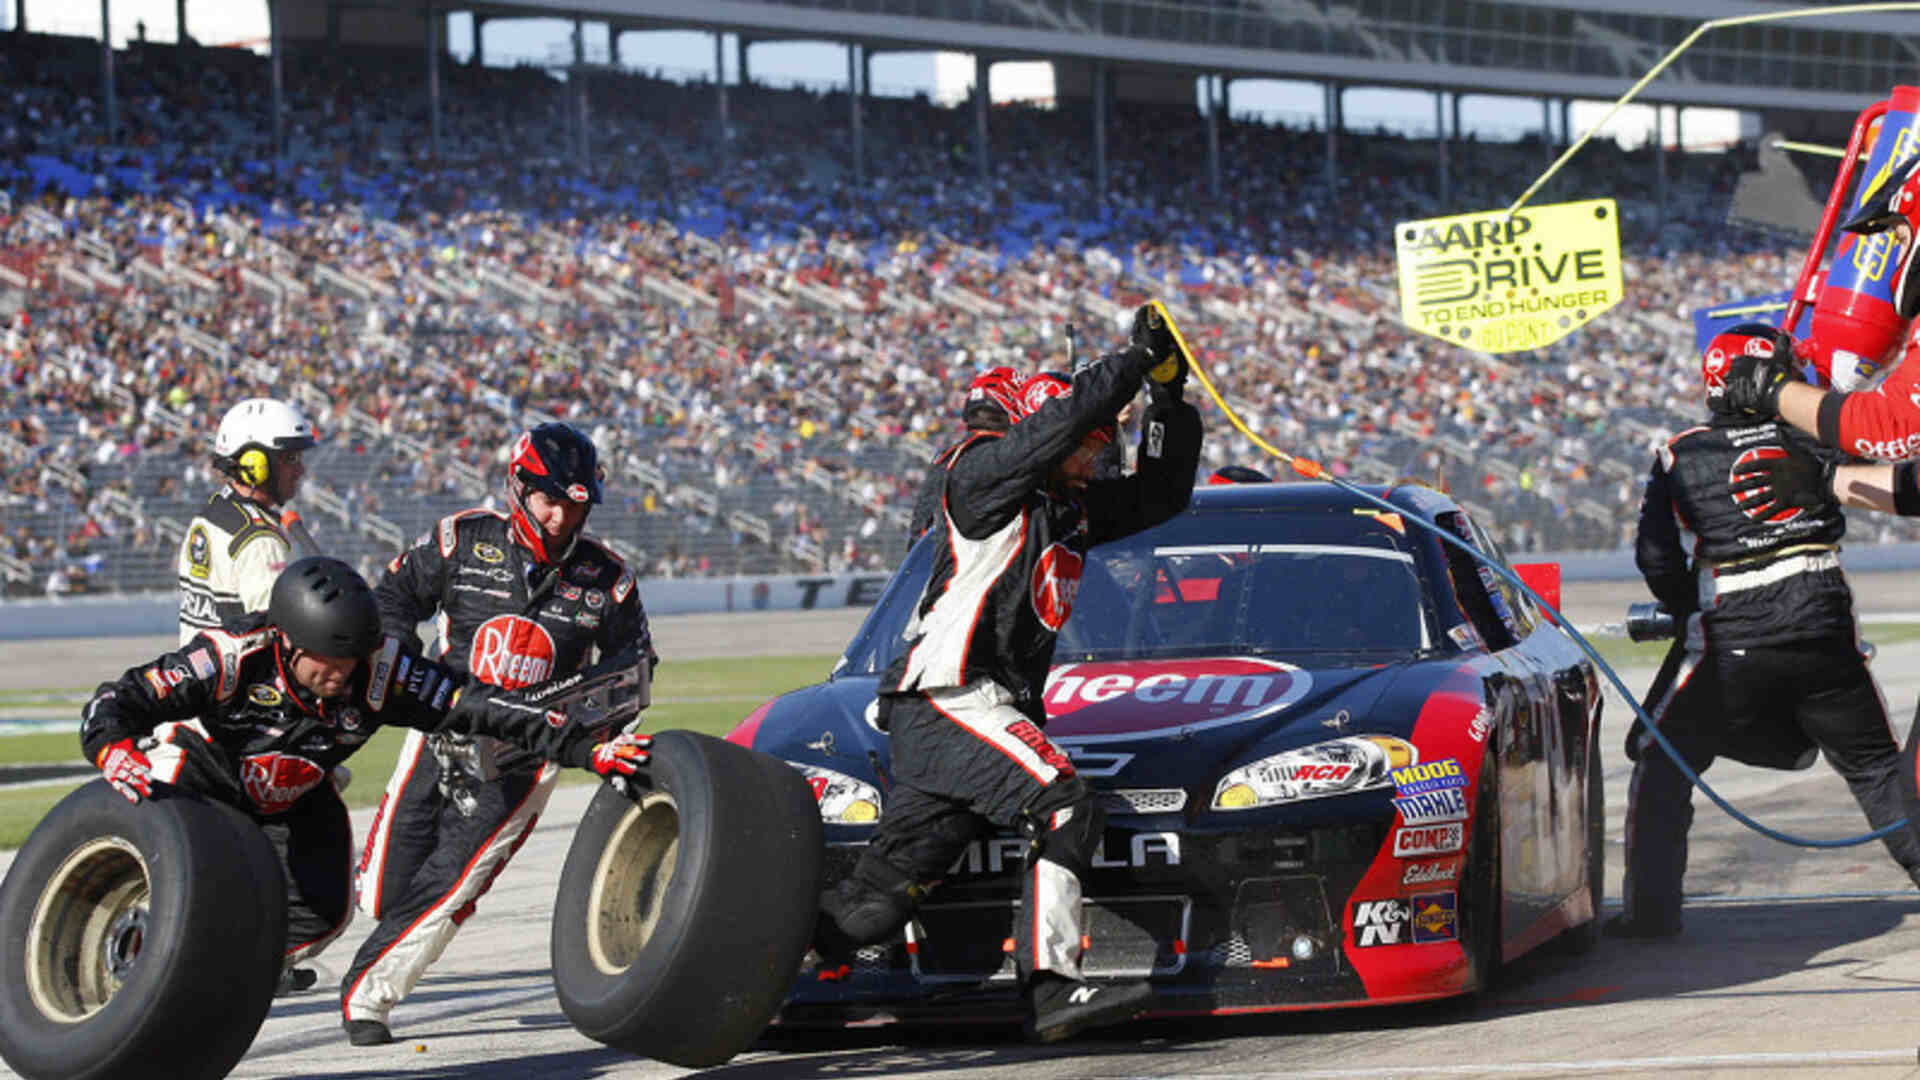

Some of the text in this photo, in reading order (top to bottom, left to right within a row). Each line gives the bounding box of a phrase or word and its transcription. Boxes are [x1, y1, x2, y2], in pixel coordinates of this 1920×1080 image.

[1420, 214, 1532, 252] AARP
[1416, 249, 1605, 306] DRIVE
[1421, 289, 1609, 326] TO END HUNGER
[476, 618, 552, 688] Rheem
[1042, 664, 1273, 707] heem
[1391, 759, 1461, 786] MOOG
[1396, 789, 1466, 819] MAHLE
